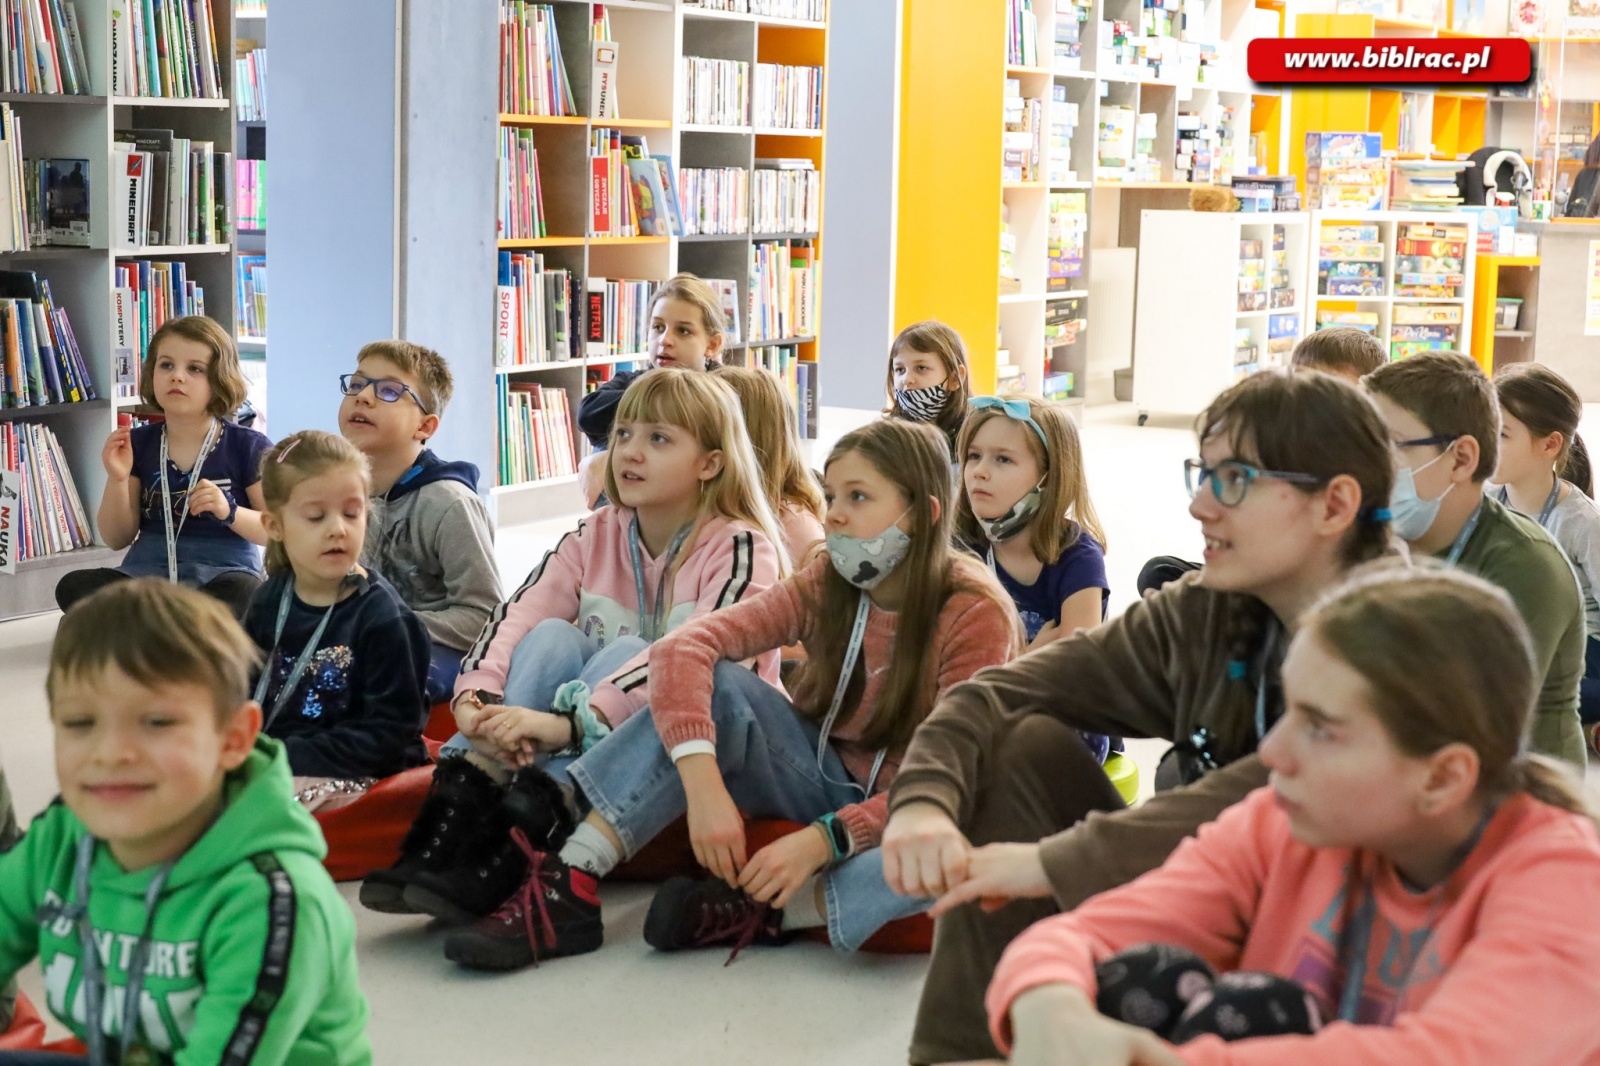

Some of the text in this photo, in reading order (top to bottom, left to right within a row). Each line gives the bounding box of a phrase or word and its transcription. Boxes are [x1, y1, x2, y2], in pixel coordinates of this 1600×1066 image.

[599, 72, 608, 117] RYSUNEK
[128, 178, 137, 243] MINECRAFT
[116, 292, 124, 346] KOMPUTERY
[500, 292, 510, 338] SPORT
[590, 296, 602, 338] NETFLIX
[0, 506, 10, 568] NAUKA
